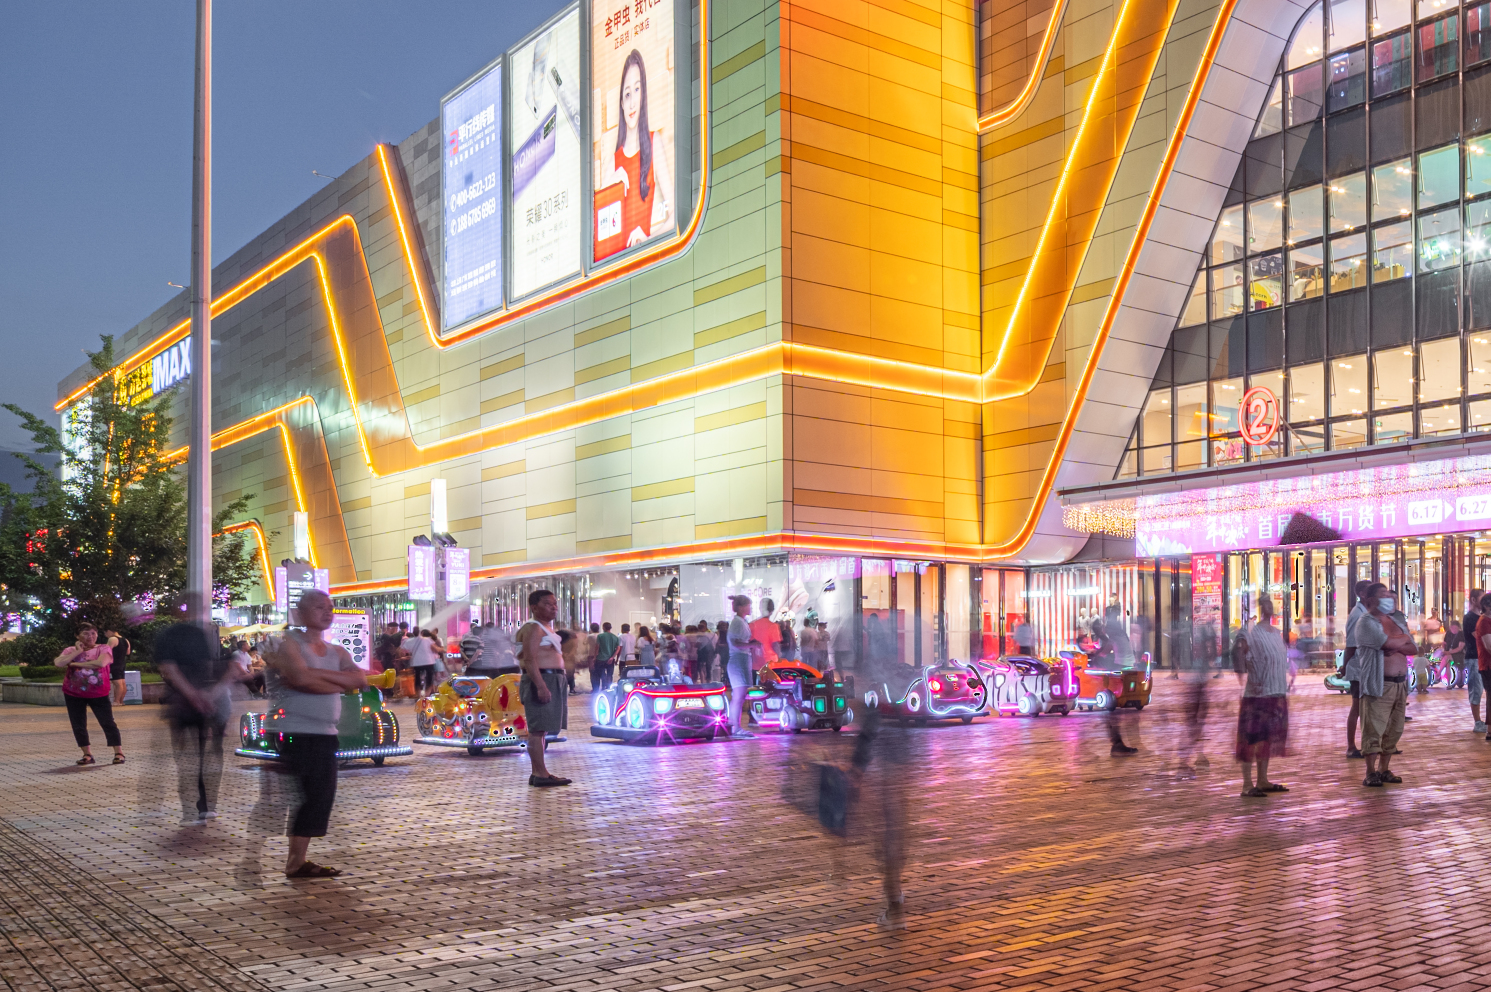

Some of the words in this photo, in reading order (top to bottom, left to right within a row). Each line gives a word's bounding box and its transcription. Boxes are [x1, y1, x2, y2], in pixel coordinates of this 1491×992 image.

[604, 4, 631, 38] 金甲虫
[152, 336, 191, 395] IMAX
[1411, 505, 1439, 521] 6.17
[1459, 500, 1488, 516] 6.27
